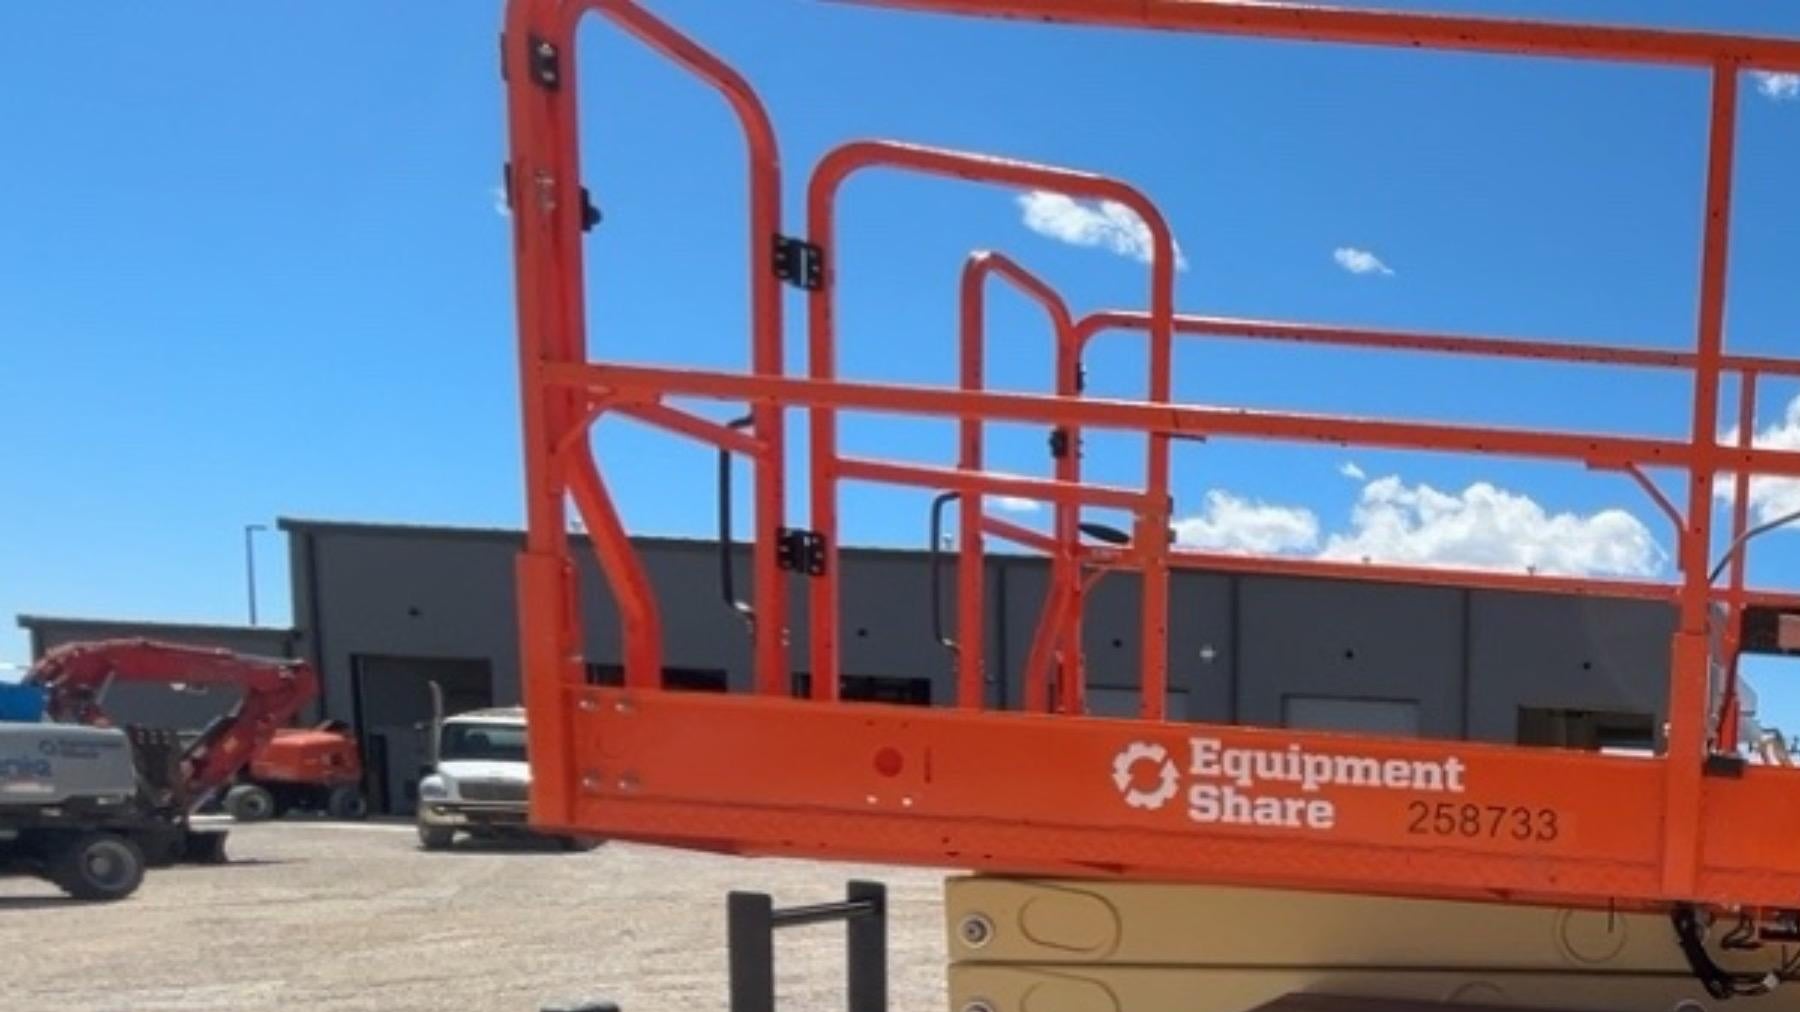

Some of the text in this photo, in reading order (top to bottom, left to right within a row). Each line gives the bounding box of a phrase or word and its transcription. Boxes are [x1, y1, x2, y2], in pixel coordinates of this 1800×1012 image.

[1188, 737, 1466, 792] Equipment
[1188, 784, 1335, 830] Share
[1407, 800, 1560, 842] 258733
